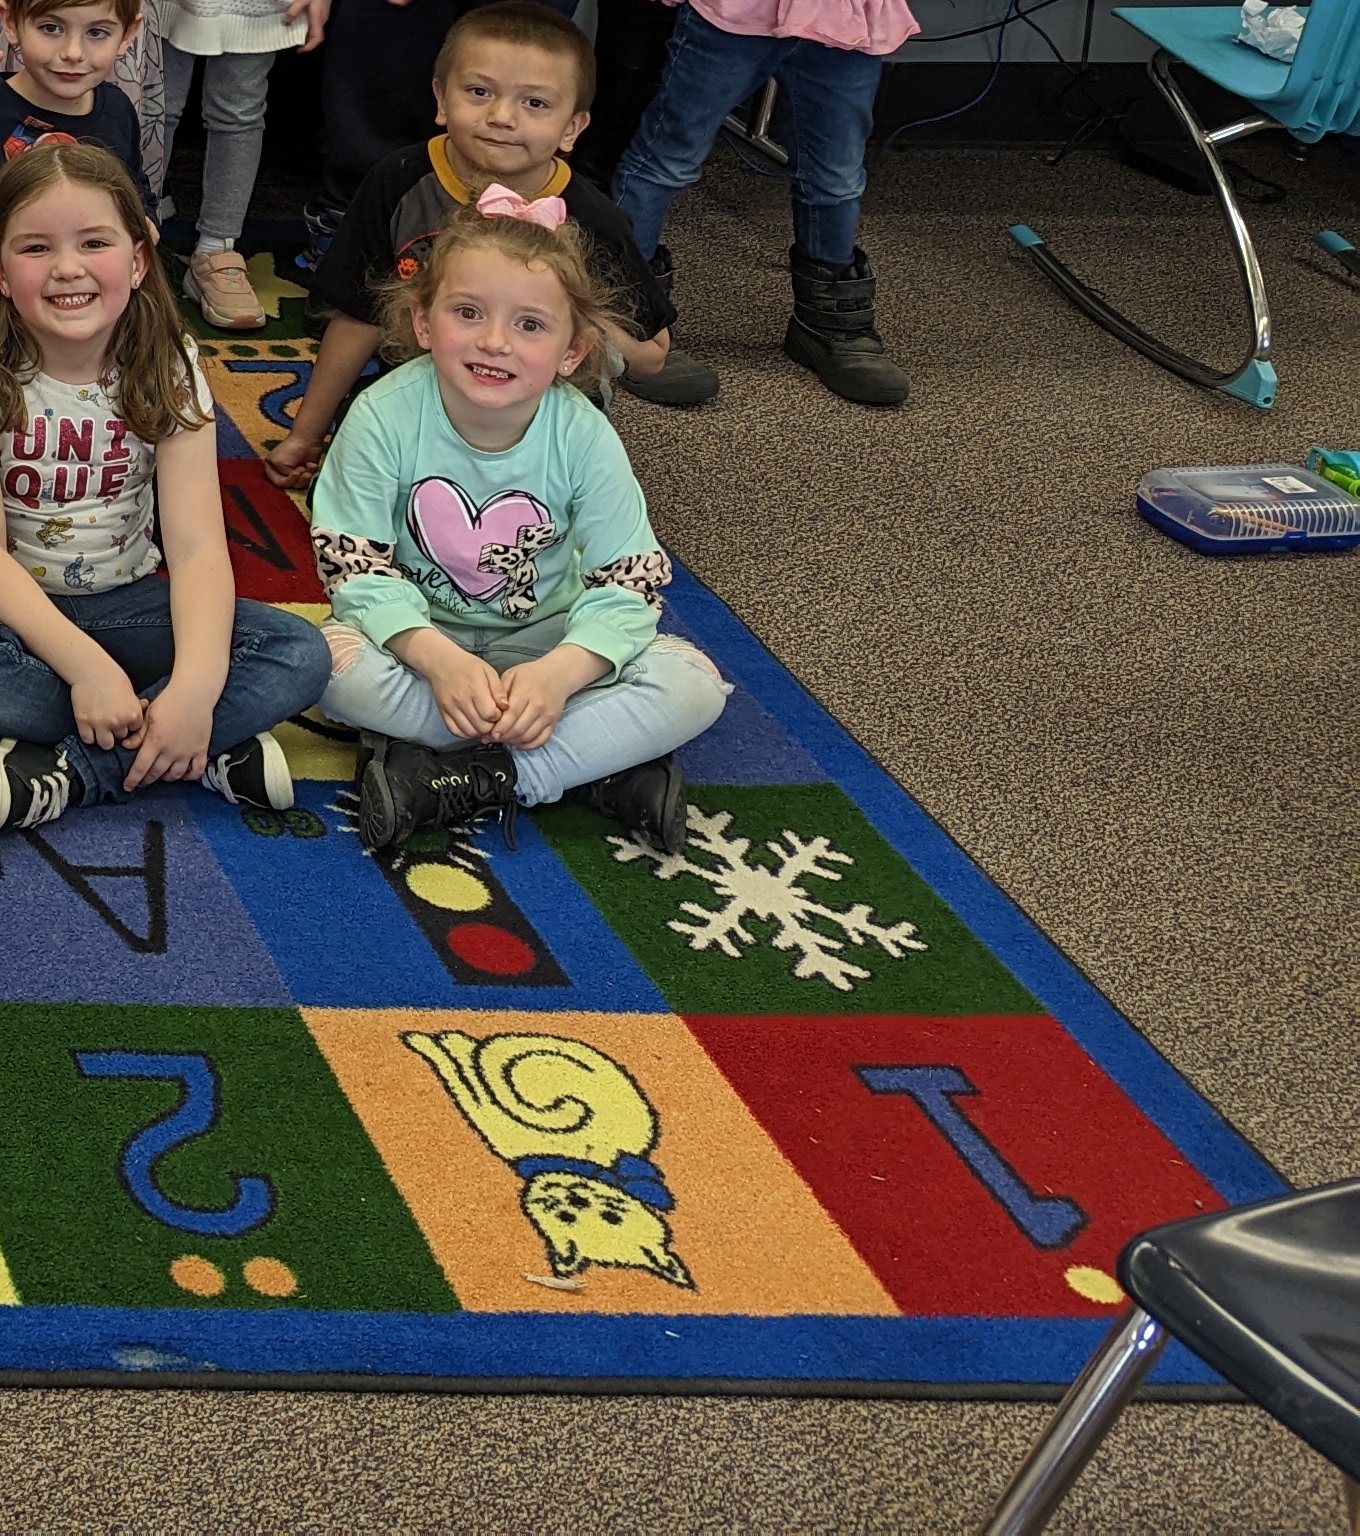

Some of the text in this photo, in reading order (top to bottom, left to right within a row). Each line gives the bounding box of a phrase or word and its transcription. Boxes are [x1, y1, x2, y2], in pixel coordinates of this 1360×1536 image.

[4, 463, 128, 510] QUE
[11, 416, 128, 462] UNI
[74, 1049, 273, 1236] 2
[852, 1065, 1090, 1249] 1
